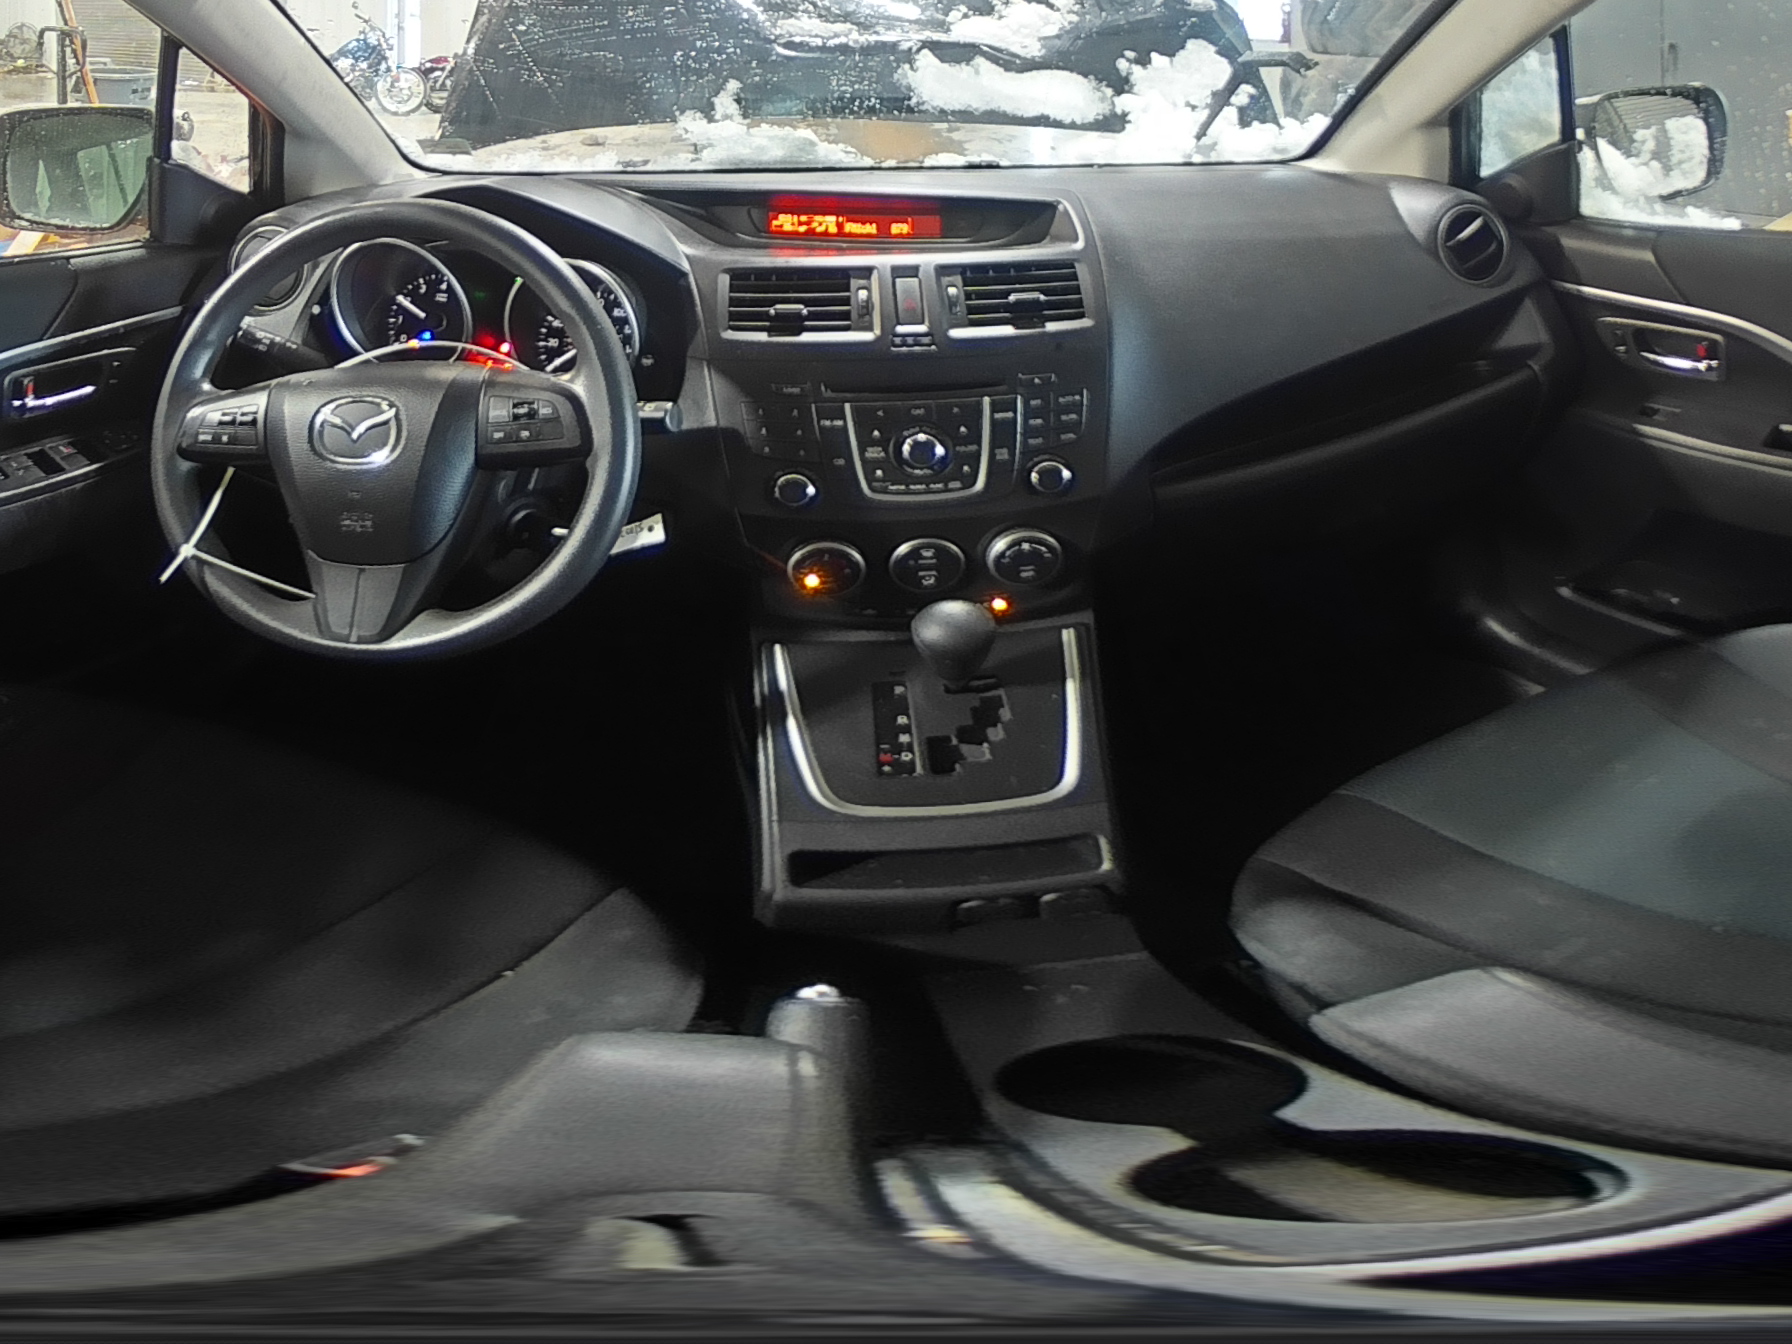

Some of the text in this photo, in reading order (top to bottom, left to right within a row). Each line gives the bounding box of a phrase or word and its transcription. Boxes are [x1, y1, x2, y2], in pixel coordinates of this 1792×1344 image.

[894, 685, 905, 697] P
[896, 715, 909, 725] R
[900, 751, 913, 761] D
